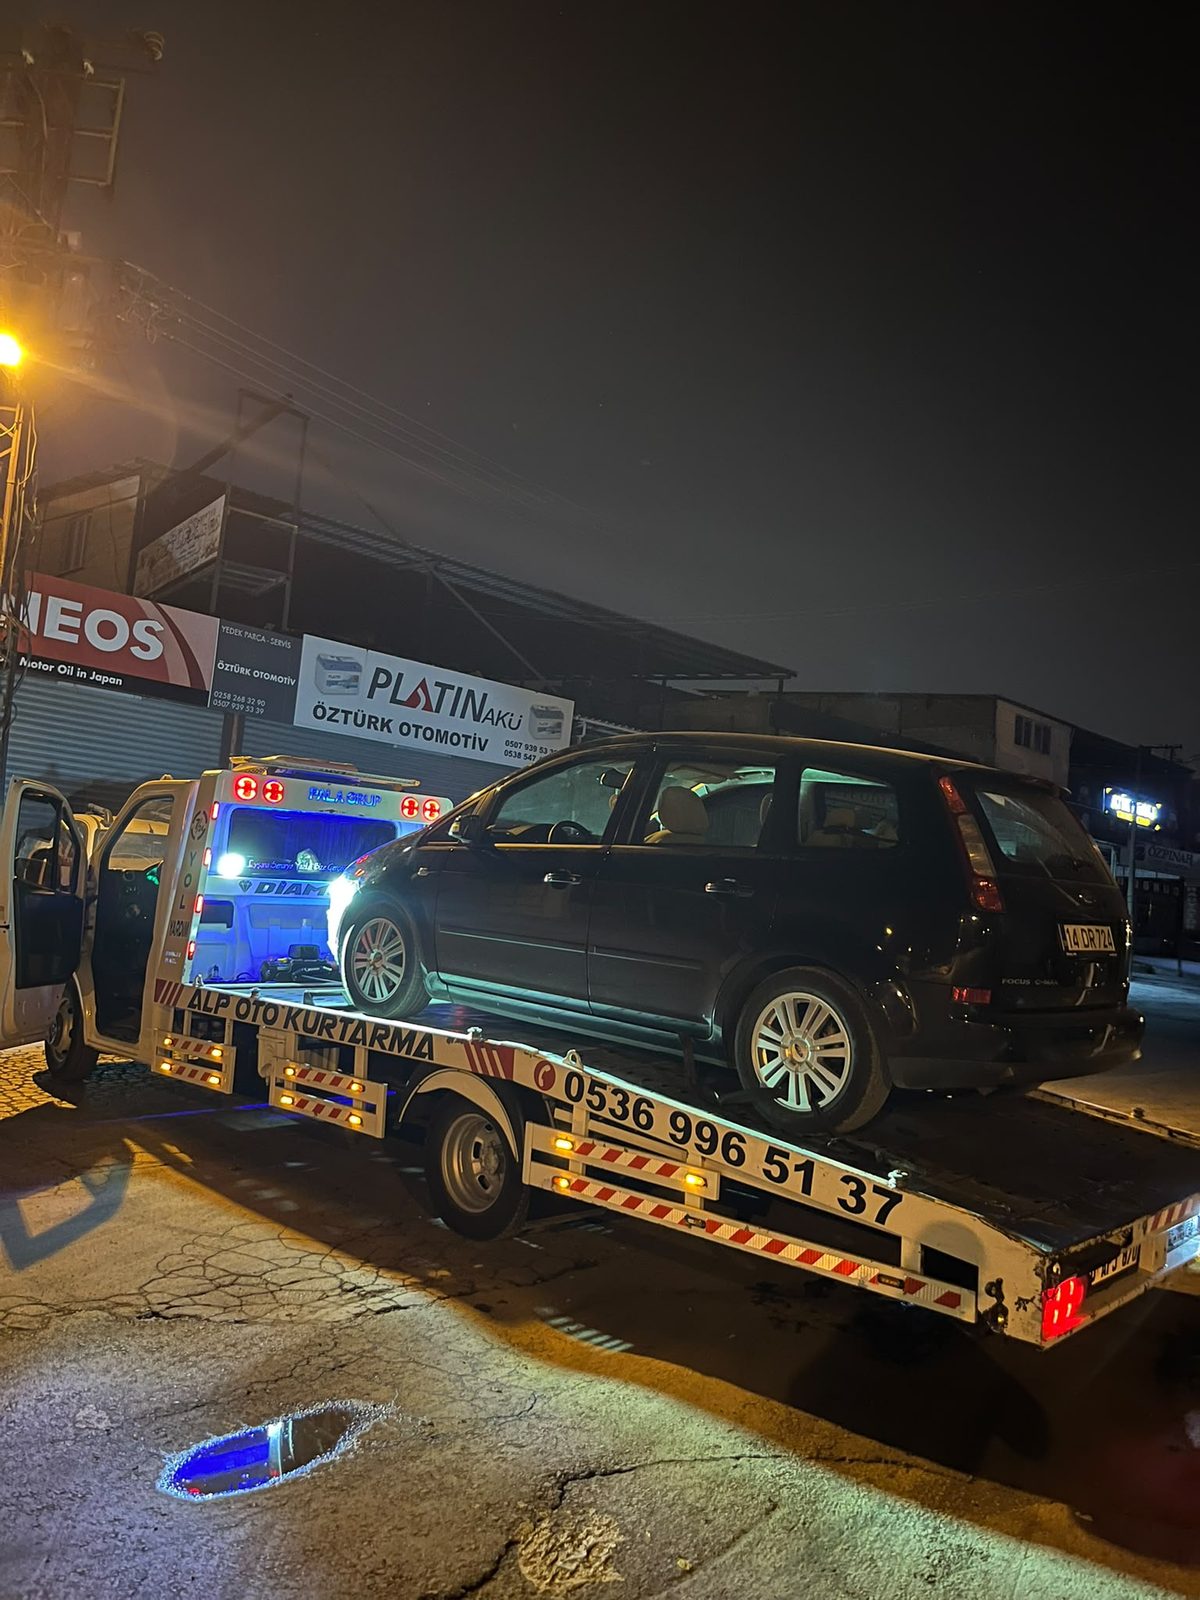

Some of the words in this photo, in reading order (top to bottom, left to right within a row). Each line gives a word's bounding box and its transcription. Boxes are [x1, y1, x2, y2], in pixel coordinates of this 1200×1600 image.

[221, 625, 243, 637] YEDEK
[244, 631, 266, 644] PARÇA
[270, 637, 292, 649] SERVİS
[19, 656, 54, 672] Motor
[57, 663, 74, 676] Oil
[76, 669, 87, 679] in
[90, 671, 123, 686] Japan
[217, 660, 251, 676] ÖZTÜRK
[253, 670, 296, 686] OTOMOTİV
[212, 698, 231, 708] 0507
[231, 702, 245, 711] 939
[245, 705, 254, 713] 53
[255, 707, 265, 715] 39
[213, 690, 231, 700] 0258
[247, 696, 256, 705] 32
[312, 701, 394, 734] ÖZTÜRK
[398, 722, 489, 751] OTOMOTİV
[481, 706, 523, 731] AKÜ
[503, 749, 522, 759] 0538
[523, 753, 537, 762] 547
[504, 739, 523, 749] 0507
[524, 743, 538, 752] 939
[539, 746, 548, 755] 53
[308, 786, 344, 803] PALA
[1066, 928, 1081, 949] 14
[1081, 928, 1097, 949] DR
[1096, 929, 1114, 949] 724
[187, 987, 231, 1015] ALP
[235, 999, 279, 1026] OTO
[283, 1006, 434, 1061] KURTARMA
[564, 1071, 655, 1131] 0536
[668, 1111, 747, 1167] 996
[762, 1146, 815, 1197] 51
[837, 1174, 904, 1226] 37
